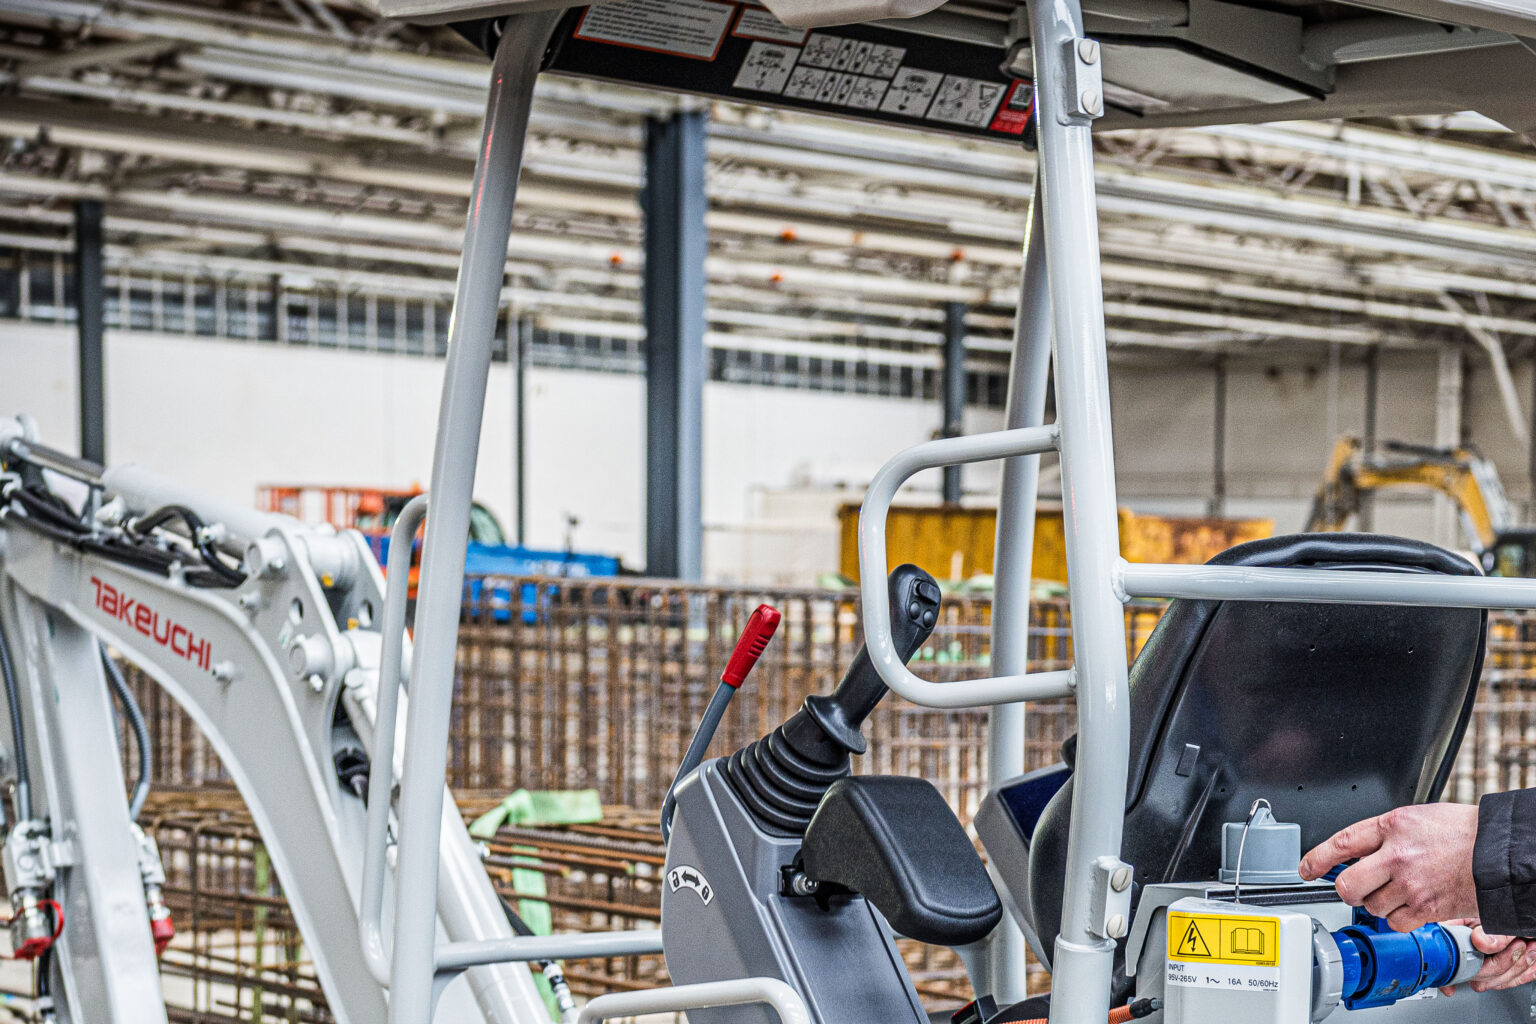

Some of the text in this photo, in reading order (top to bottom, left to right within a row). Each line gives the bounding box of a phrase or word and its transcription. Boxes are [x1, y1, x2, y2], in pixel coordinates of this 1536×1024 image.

[91, 576, 212, 671] TAKEUCHI
[1168, 963, 1184, 972] INPUT
[1168, 973, 1197, 983] 95V-265V
[1228, 977, 1242, 986] 16A
[1248, 979, 1279, 988] 50/60Hz
